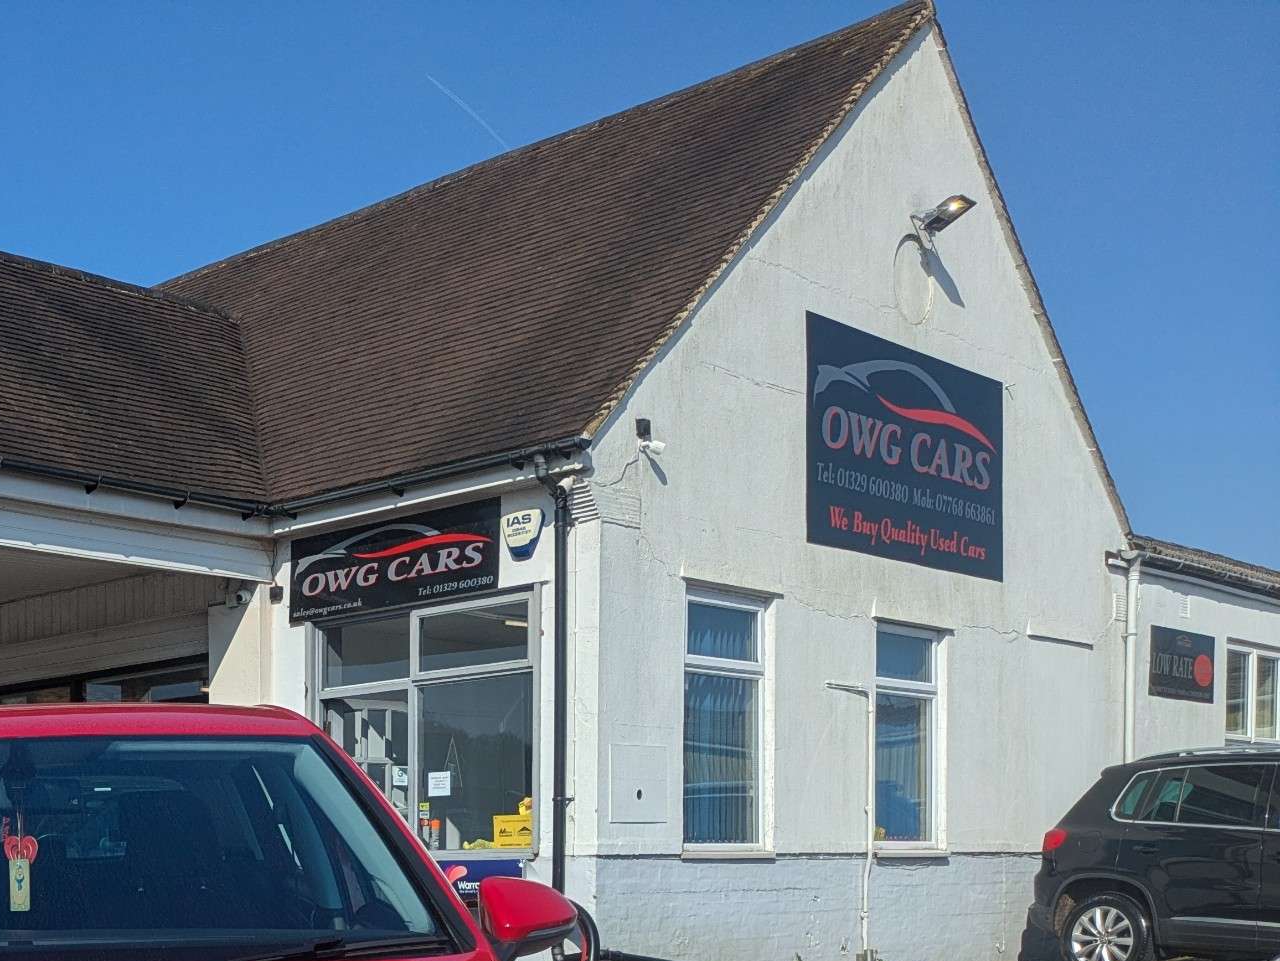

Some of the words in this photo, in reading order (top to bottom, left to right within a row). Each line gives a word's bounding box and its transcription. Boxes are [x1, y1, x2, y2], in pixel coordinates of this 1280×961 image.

[822, 405, 902, 465] OWG
[910, 432, 991, 491] CARS
[817, 462, 835, 485] Tel:
[837, 468, 867, 493] 01329
[869, 476, 909, 501] 600380
[913, 487, 934, 509] Mob:
[935, 494, 964, 517] 07768
[507, 513, 531, 528] IAS
[829, 505, 849, 531] We
[853, 511, 879, 545] Buy
[880, 518, 928, 556] Quality
[930, 528, 957, 554] Used
[960, 536, 987, 560] Cars
[301, 562, 379, 597] OWG
[387, 542, 485, 582] CARS
[418, 585, 432, 596] Tel:
[433, 581, 458, 594] 01329
[459, 575, 494, 589] 600380
[1152, 652, 1171, 676] LOW
[1172, 655, 1193, 679] RATE
[458, 881, 480, 890] Warra
